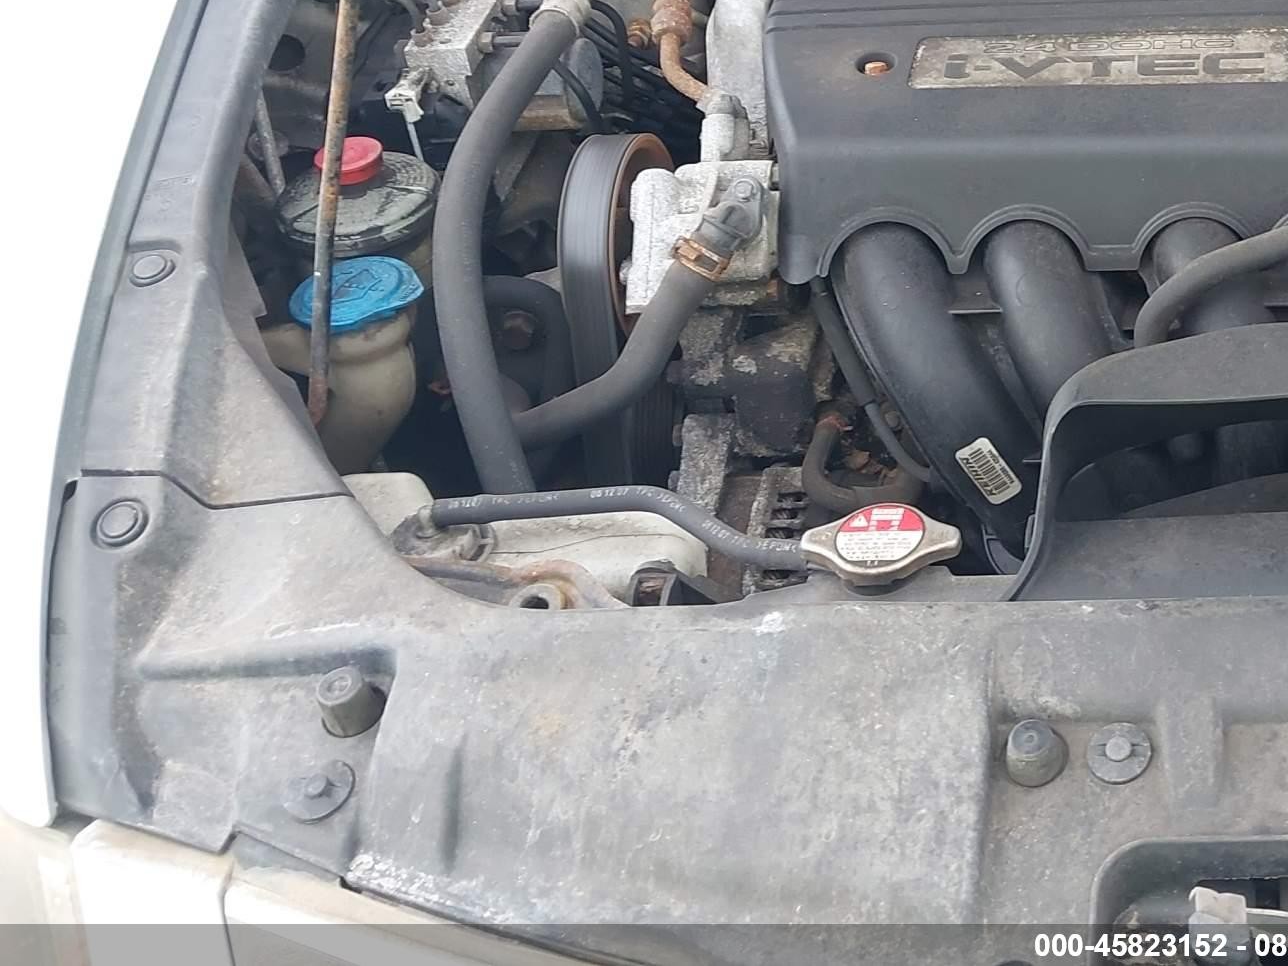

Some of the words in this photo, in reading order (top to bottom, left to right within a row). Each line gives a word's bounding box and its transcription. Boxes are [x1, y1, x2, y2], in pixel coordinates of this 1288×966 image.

[983, 42, 1057, 54] 2.4
[1067, 38, 1236, 52] DOHC
[943, 52, 1265, 80] i-VTEC
